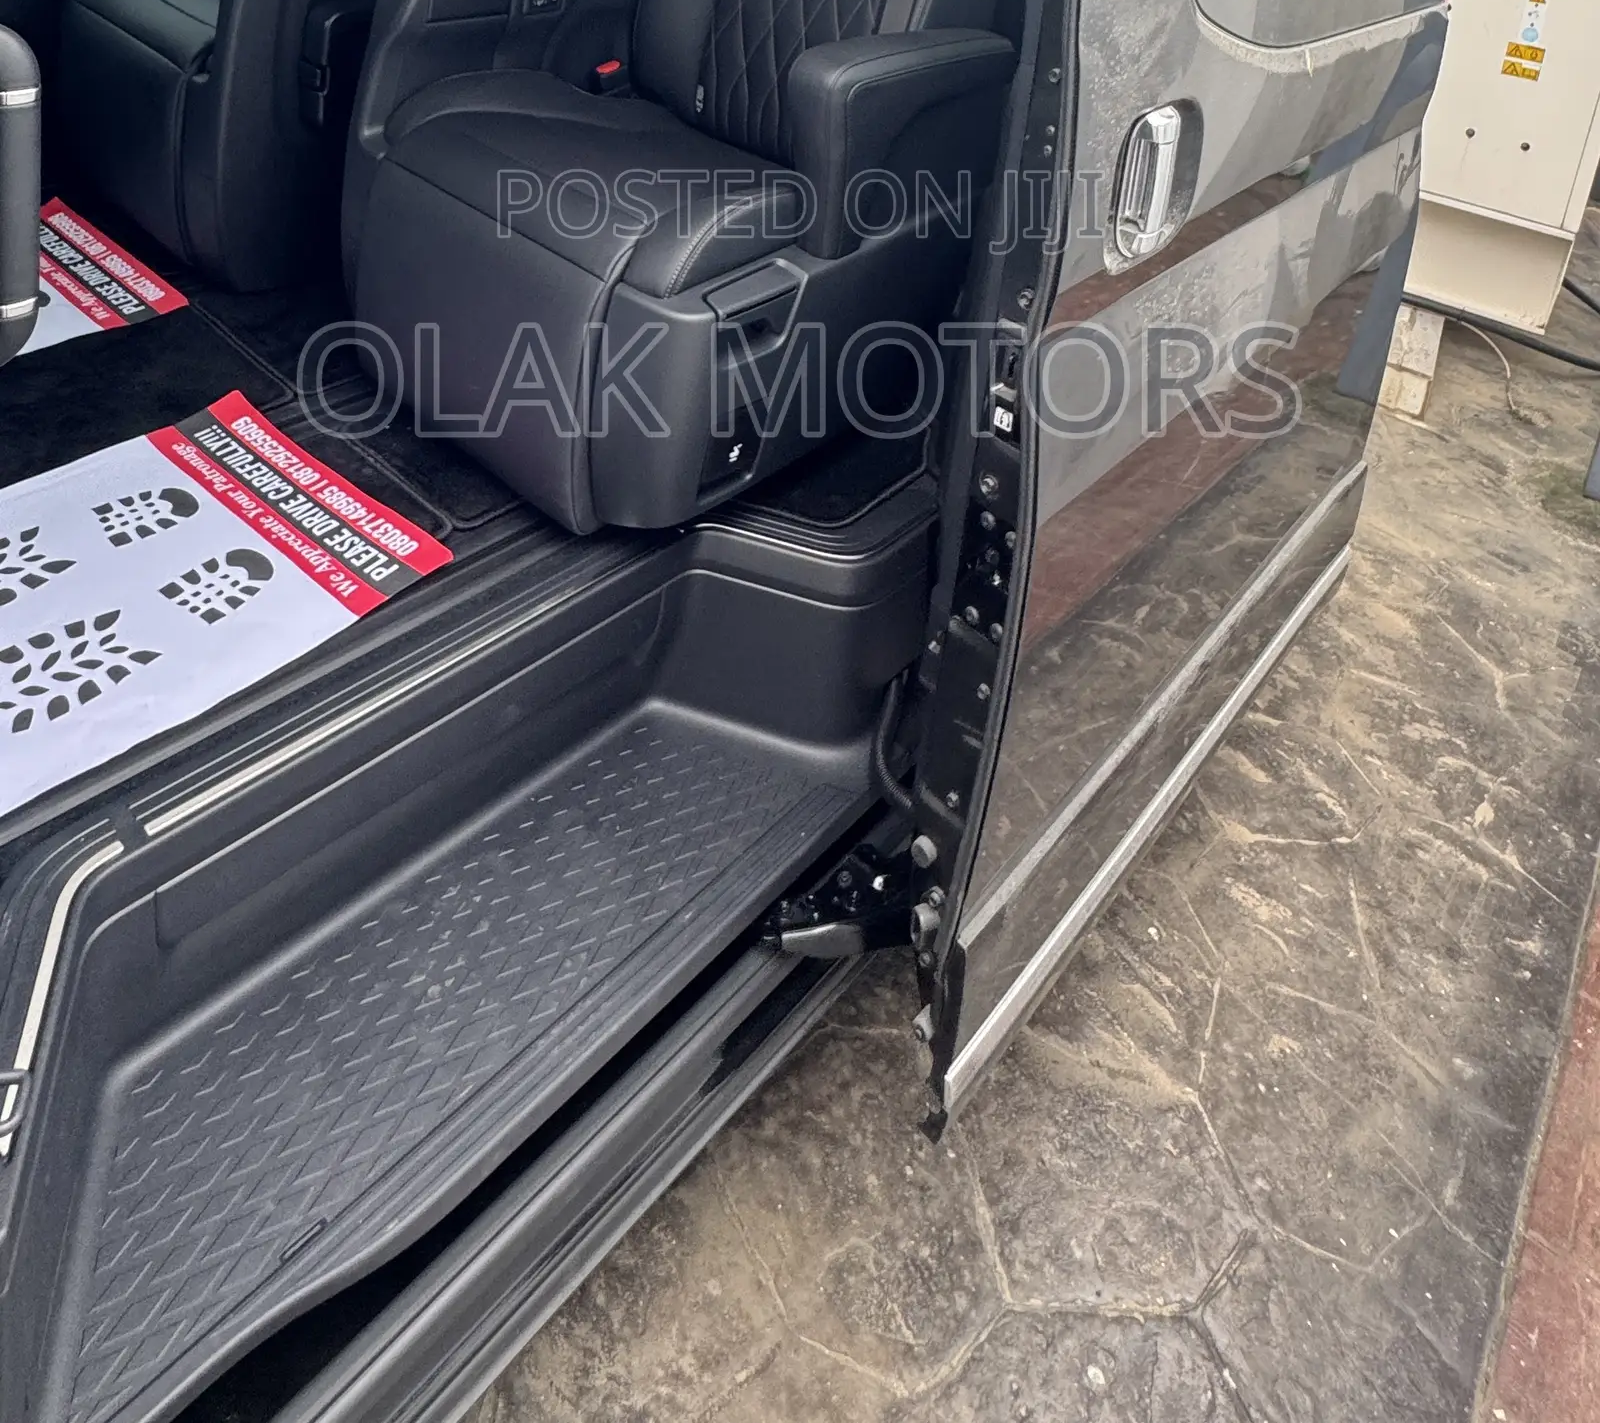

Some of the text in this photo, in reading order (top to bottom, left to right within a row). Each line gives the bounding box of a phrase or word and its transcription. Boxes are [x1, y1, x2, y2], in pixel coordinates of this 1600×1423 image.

[69, 261, 111, 286] DRIVE
[95, 280, 146, 315] PLEASE
[230, 416, 321, 485] 08129255609
[171, 442, 359, 598] We Appreciate Your Patronage
[194, 425, 399, 581] PLEASE DRIVE CAREFULLY!!!
[319, 485, 420, 557] 08037149985
